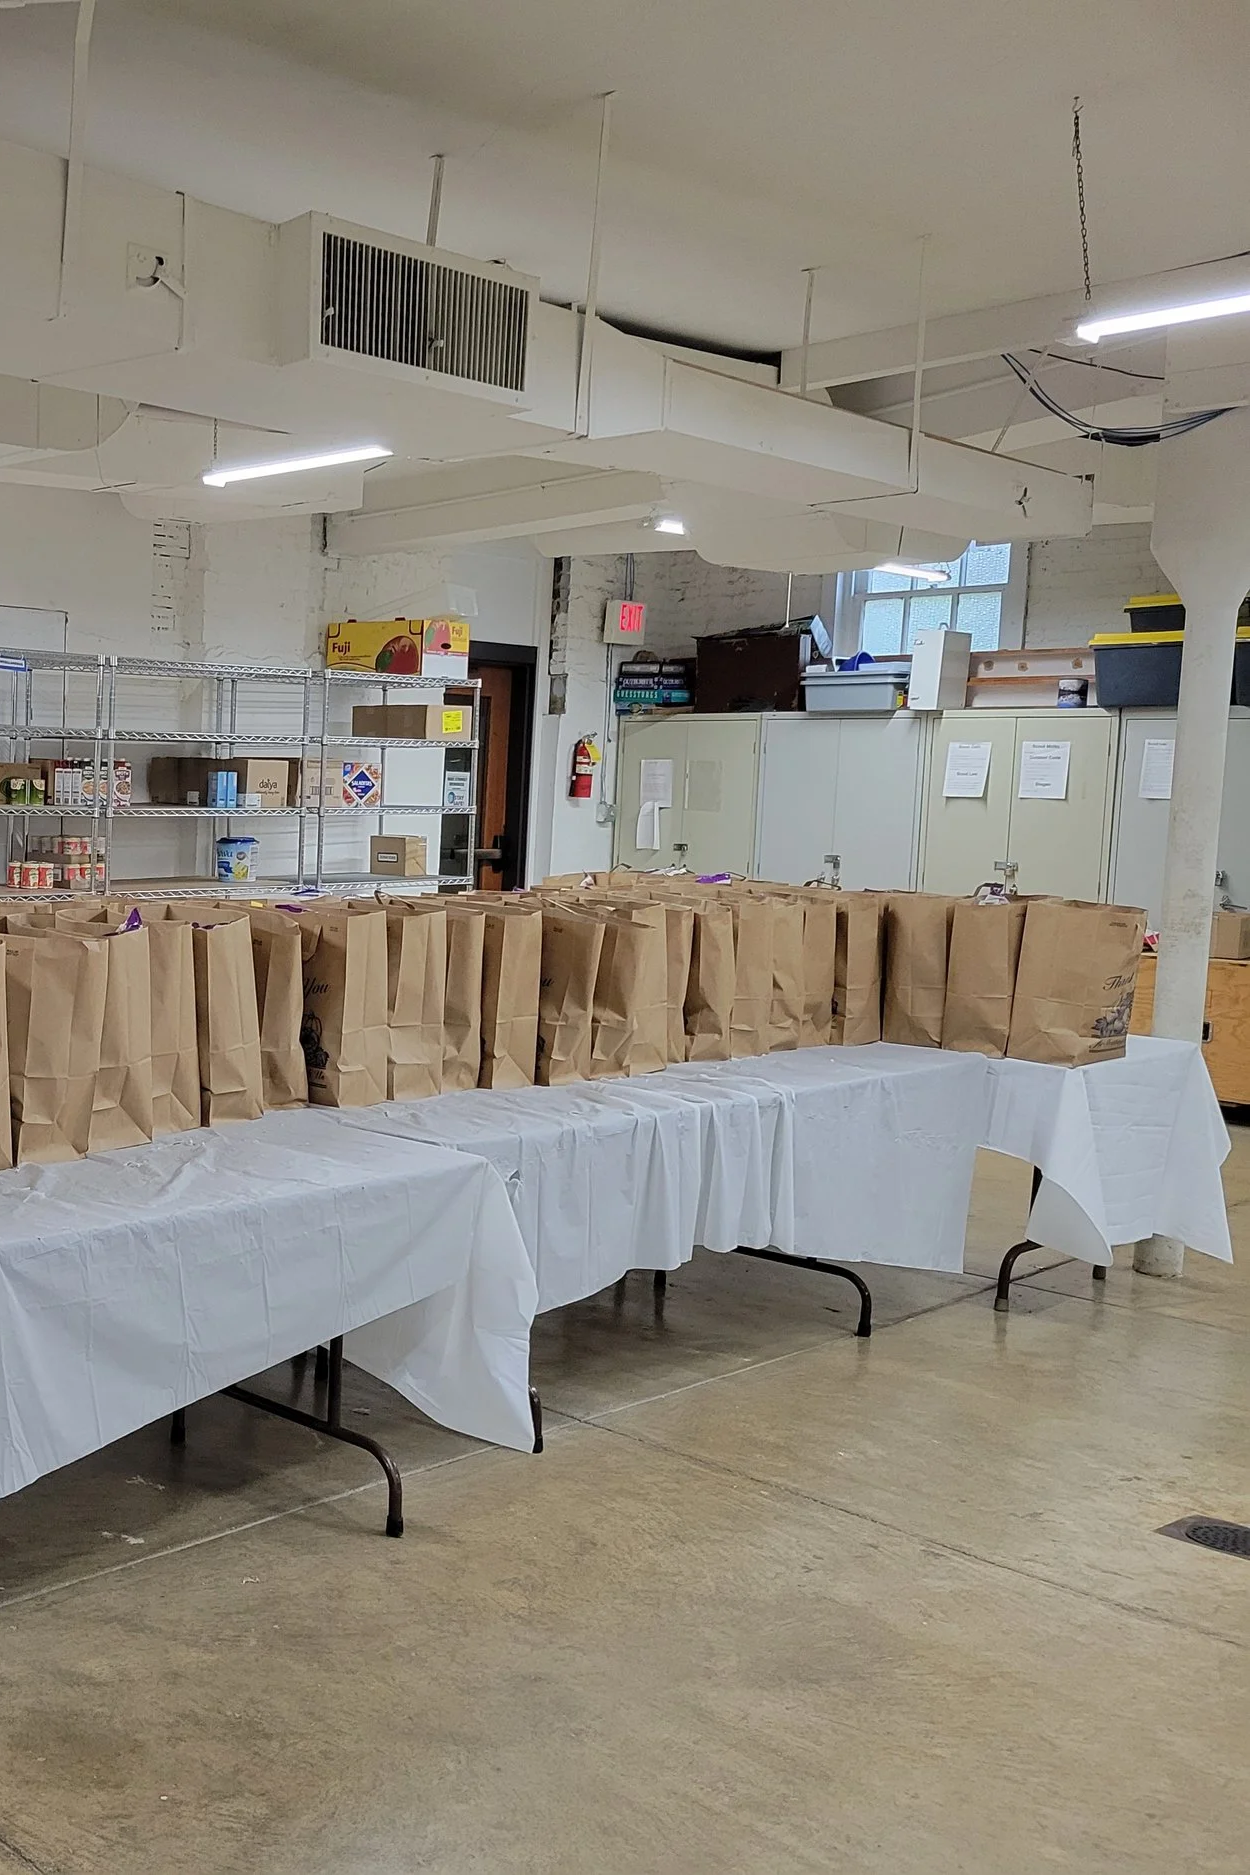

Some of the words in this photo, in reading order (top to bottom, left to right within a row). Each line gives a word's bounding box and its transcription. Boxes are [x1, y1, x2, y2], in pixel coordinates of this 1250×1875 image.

[620, 604, 643, 631] EXIT
[452, 626, 463, 636] Fuji
[332, 642, 351, 655] Fuji
[616, 690, 658, 699] GUESSTURES
[258, 778, 278, 790] daiya
